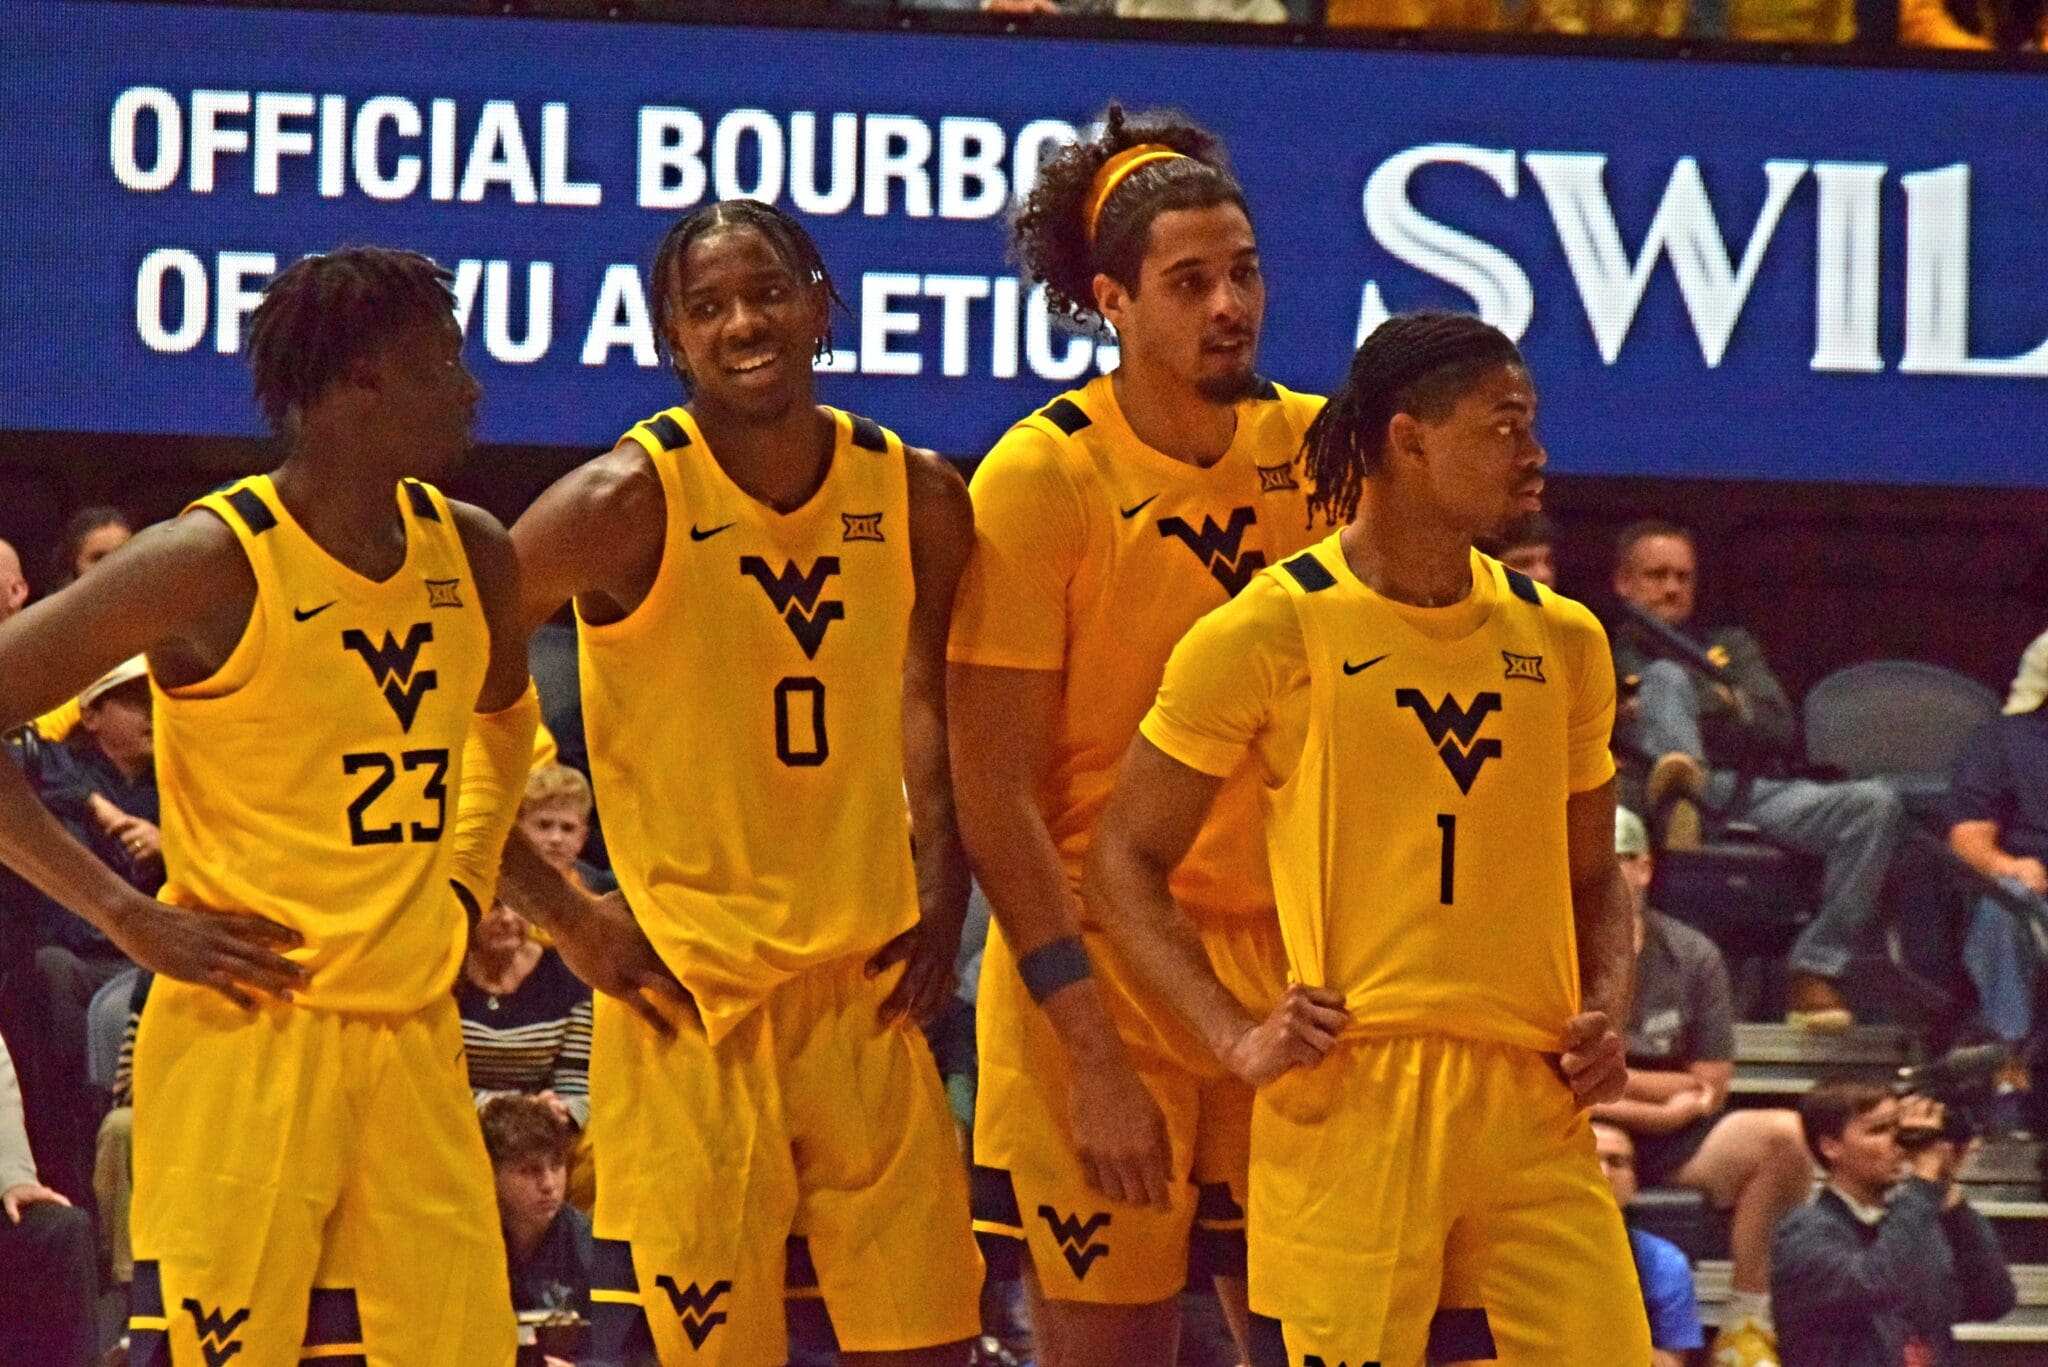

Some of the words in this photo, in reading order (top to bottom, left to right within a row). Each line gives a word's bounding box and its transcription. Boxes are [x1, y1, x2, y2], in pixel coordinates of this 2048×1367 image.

[111, 87, 602, 206] OFFICIAL
[637, 106, 1107, 226] BOURBO
[136, 249, 277, 354] OF
[580, 264, 1121, 380] AETIC
[773, 677, 829, 767] 0
[342, 748, 450, 846] 23
[1436, 813, 1457, 906] 1
